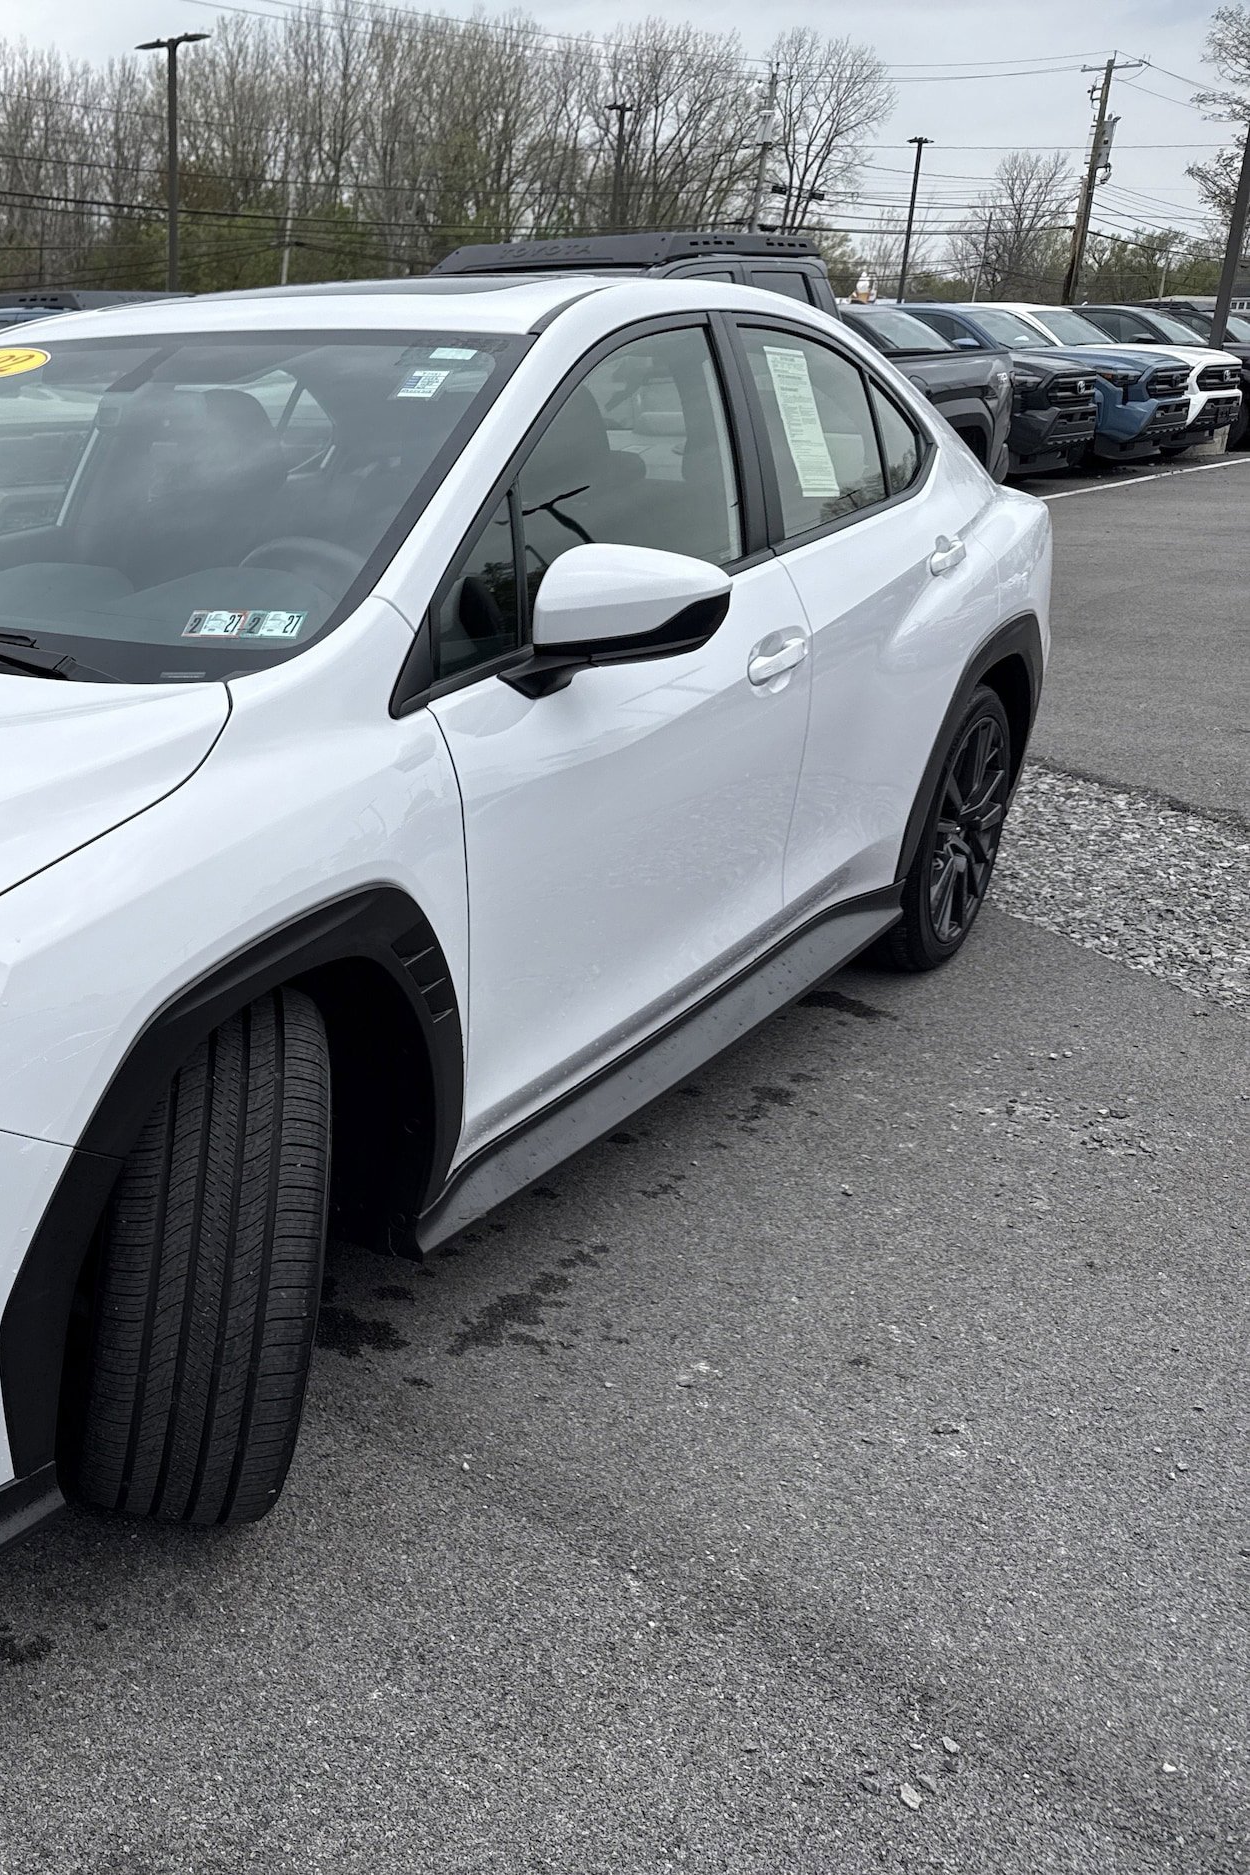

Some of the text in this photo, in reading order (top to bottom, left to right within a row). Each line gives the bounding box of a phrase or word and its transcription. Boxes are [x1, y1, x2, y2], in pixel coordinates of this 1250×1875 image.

[499, 244, 591, 259] TOYOTA
[188, 614, 243, 633] 2 27
[248, 615, 302, 634] 2 27
